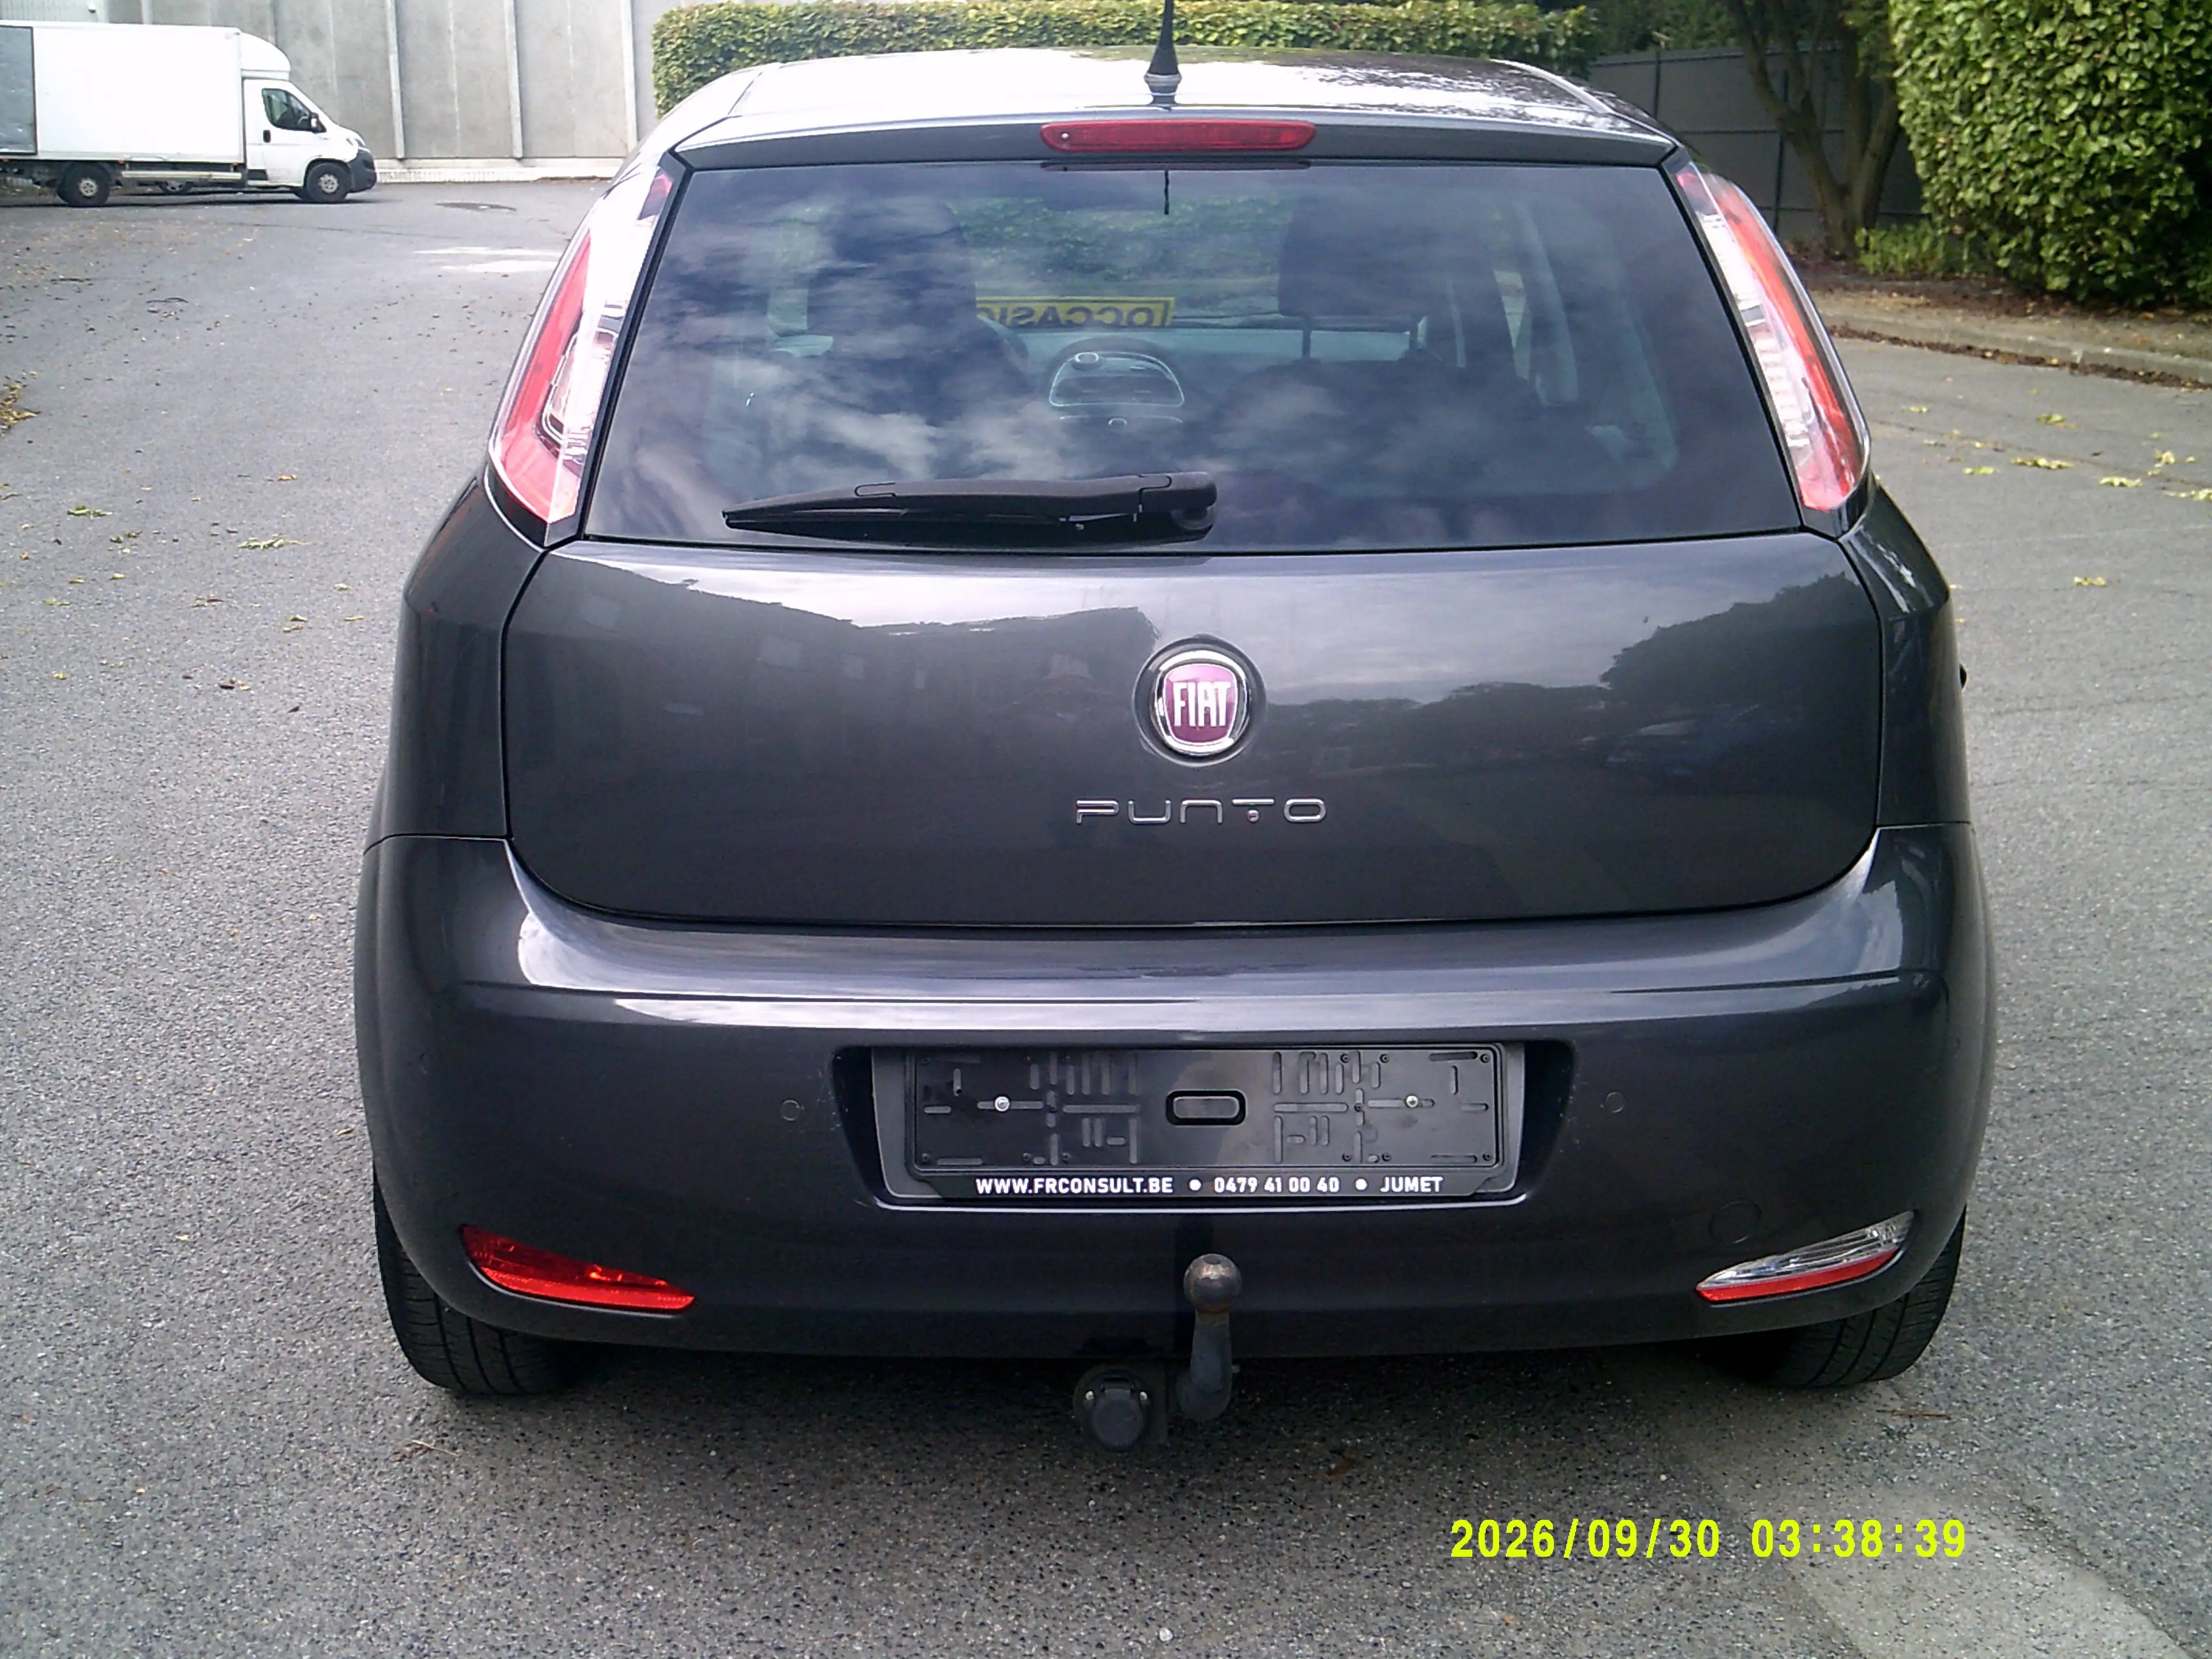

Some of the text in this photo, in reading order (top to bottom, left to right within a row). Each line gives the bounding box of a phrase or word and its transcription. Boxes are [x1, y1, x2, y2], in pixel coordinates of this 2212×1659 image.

[1173, 681, 1231, 727] FIAT
[1075, 797, 1326, 824] PUNTO
[976, 1176, 1444, 1194] WWW.FRCONSULT.BE 0479 41 00 40 JUMET
